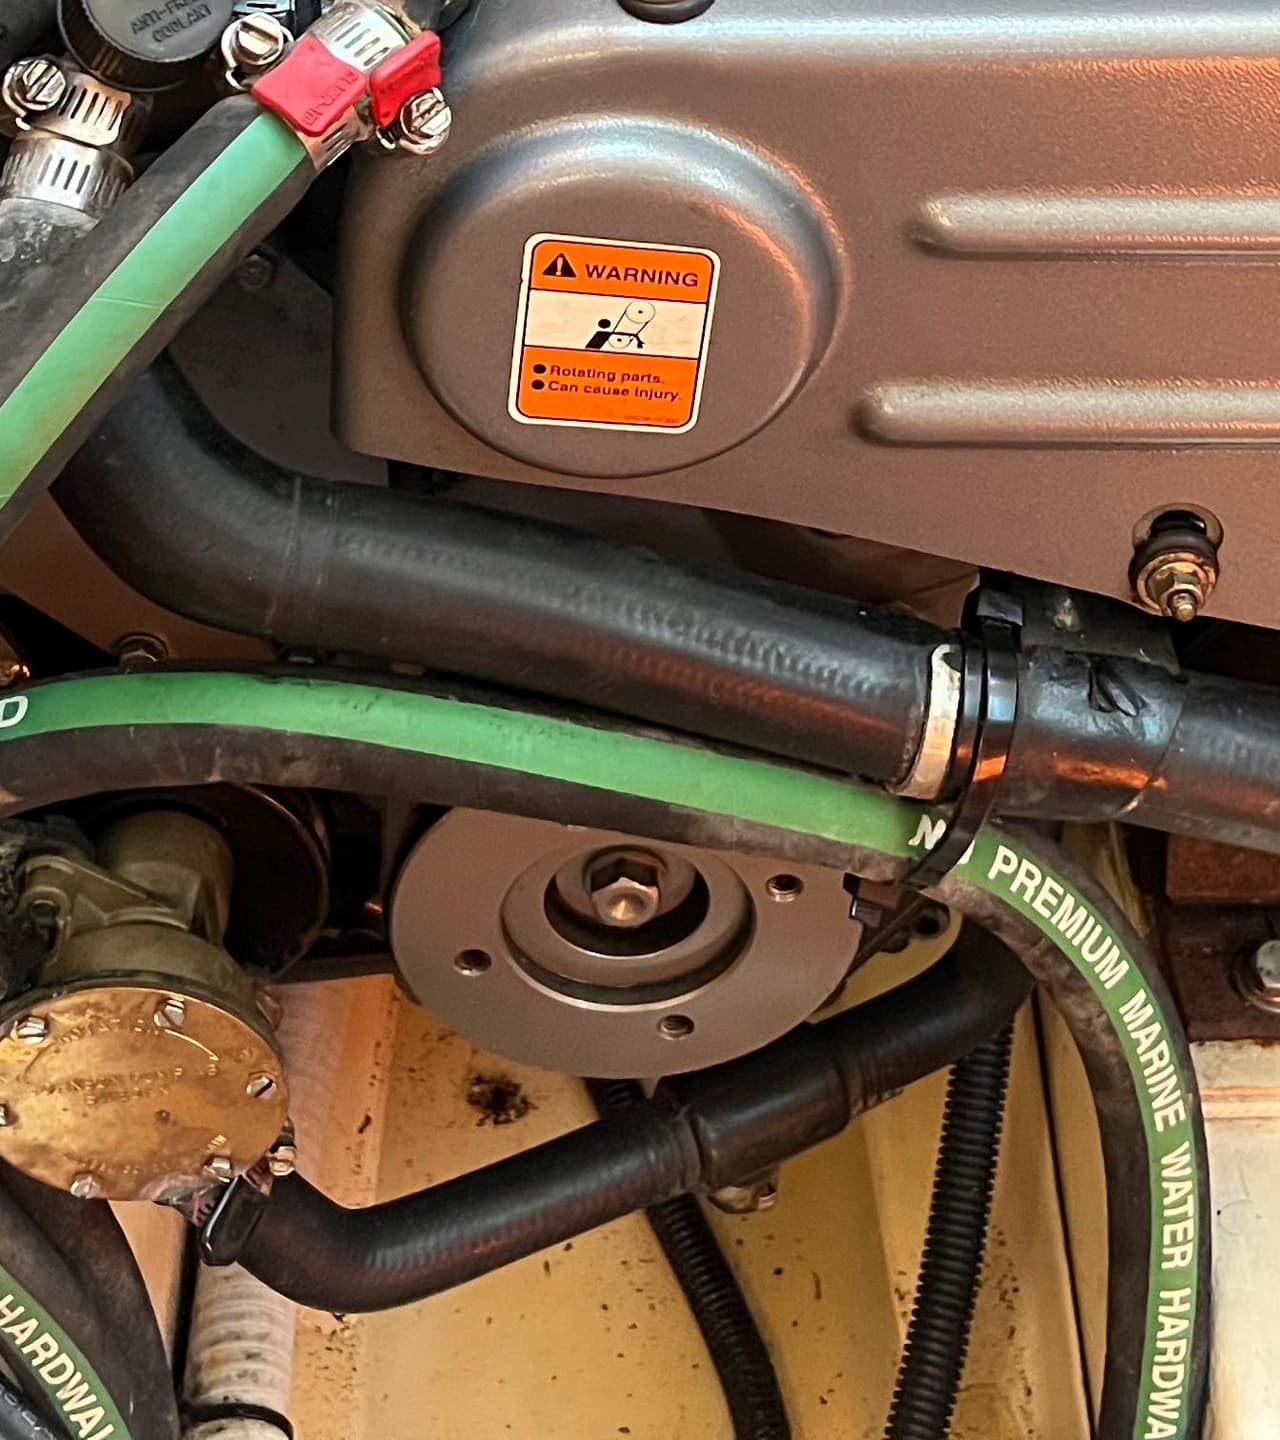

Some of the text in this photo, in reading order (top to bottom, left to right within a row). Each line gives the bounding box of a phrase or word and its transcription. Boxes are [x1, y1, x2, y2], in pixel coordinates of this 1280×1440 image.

[152, 3, 212, 43] COOLANT
[585, 263, 699, 287] WARNING
[549, 364, 665, 385] Rotating parts.
[548, 380, 579, 393] Can
[584, 383, 629, 397] cause
[987, 844, 1131, 991] PREMIUM
[1118, 988, 1187, 1133] MARINE
[1160, 1140, 1194, 1270] WATER
